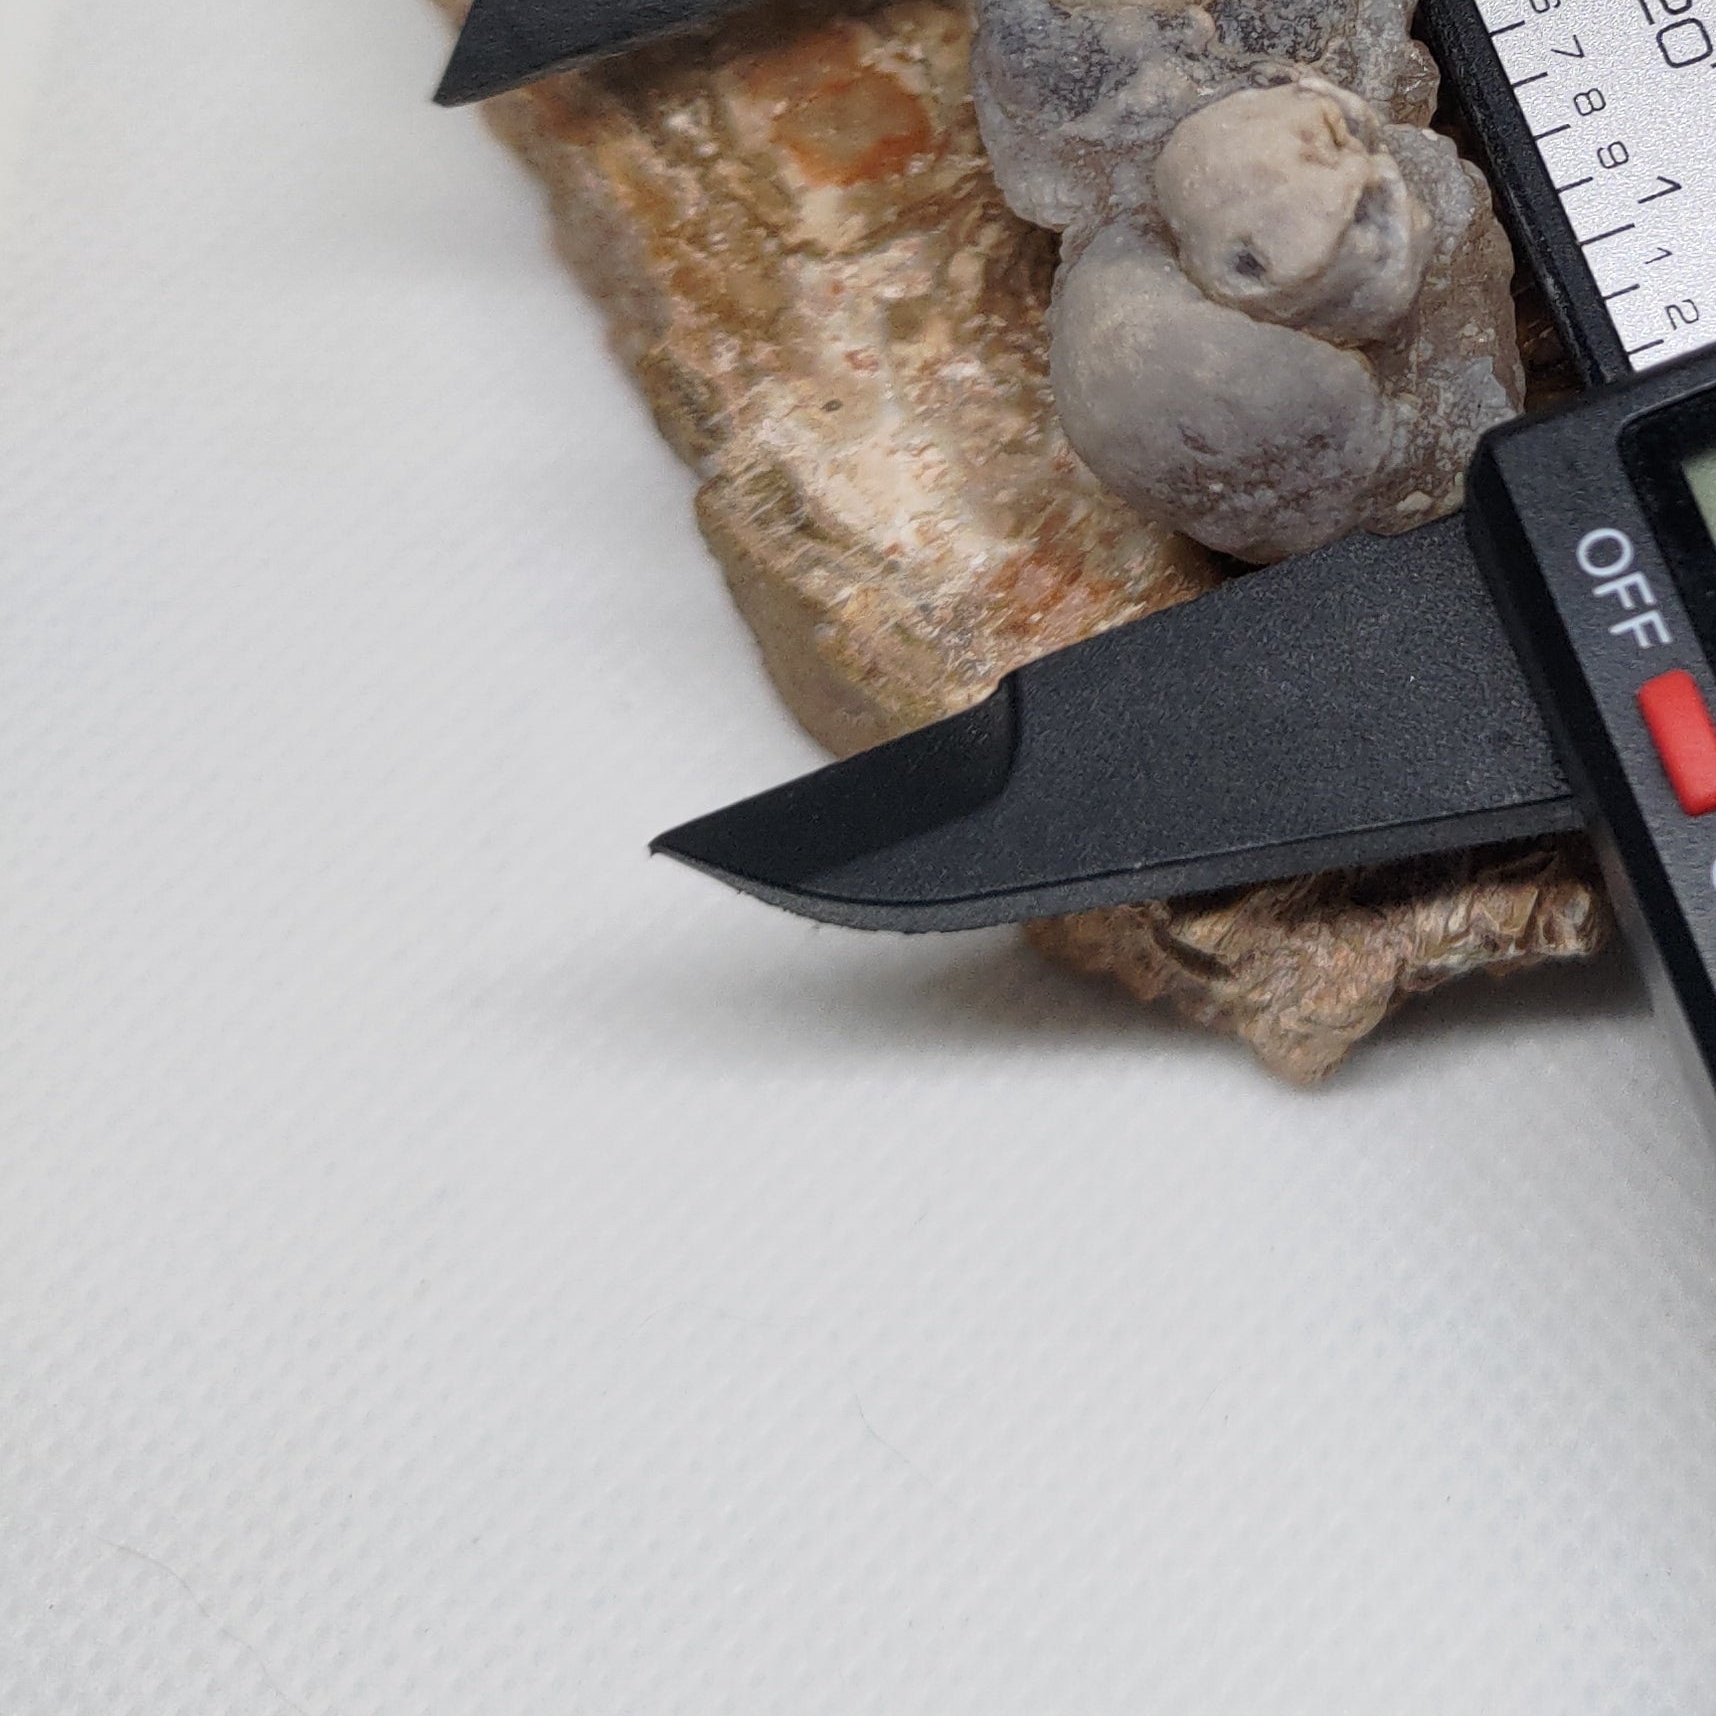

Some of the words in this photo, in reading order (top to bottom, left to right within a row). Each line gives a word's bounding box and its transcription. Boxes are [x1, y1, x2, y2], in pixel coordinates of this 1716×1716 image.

[1551, 34, 1585, 59] 7
[1572, 88, 1606, 116] 8
[1596, 141, 1629, 170] 9
[1638, 175, 1683, 204] 1
[1644, 246, 1672, 266] 1
[1665, 300, 1701, 330] 2
[1576, 527, 1671, 654] OFF
